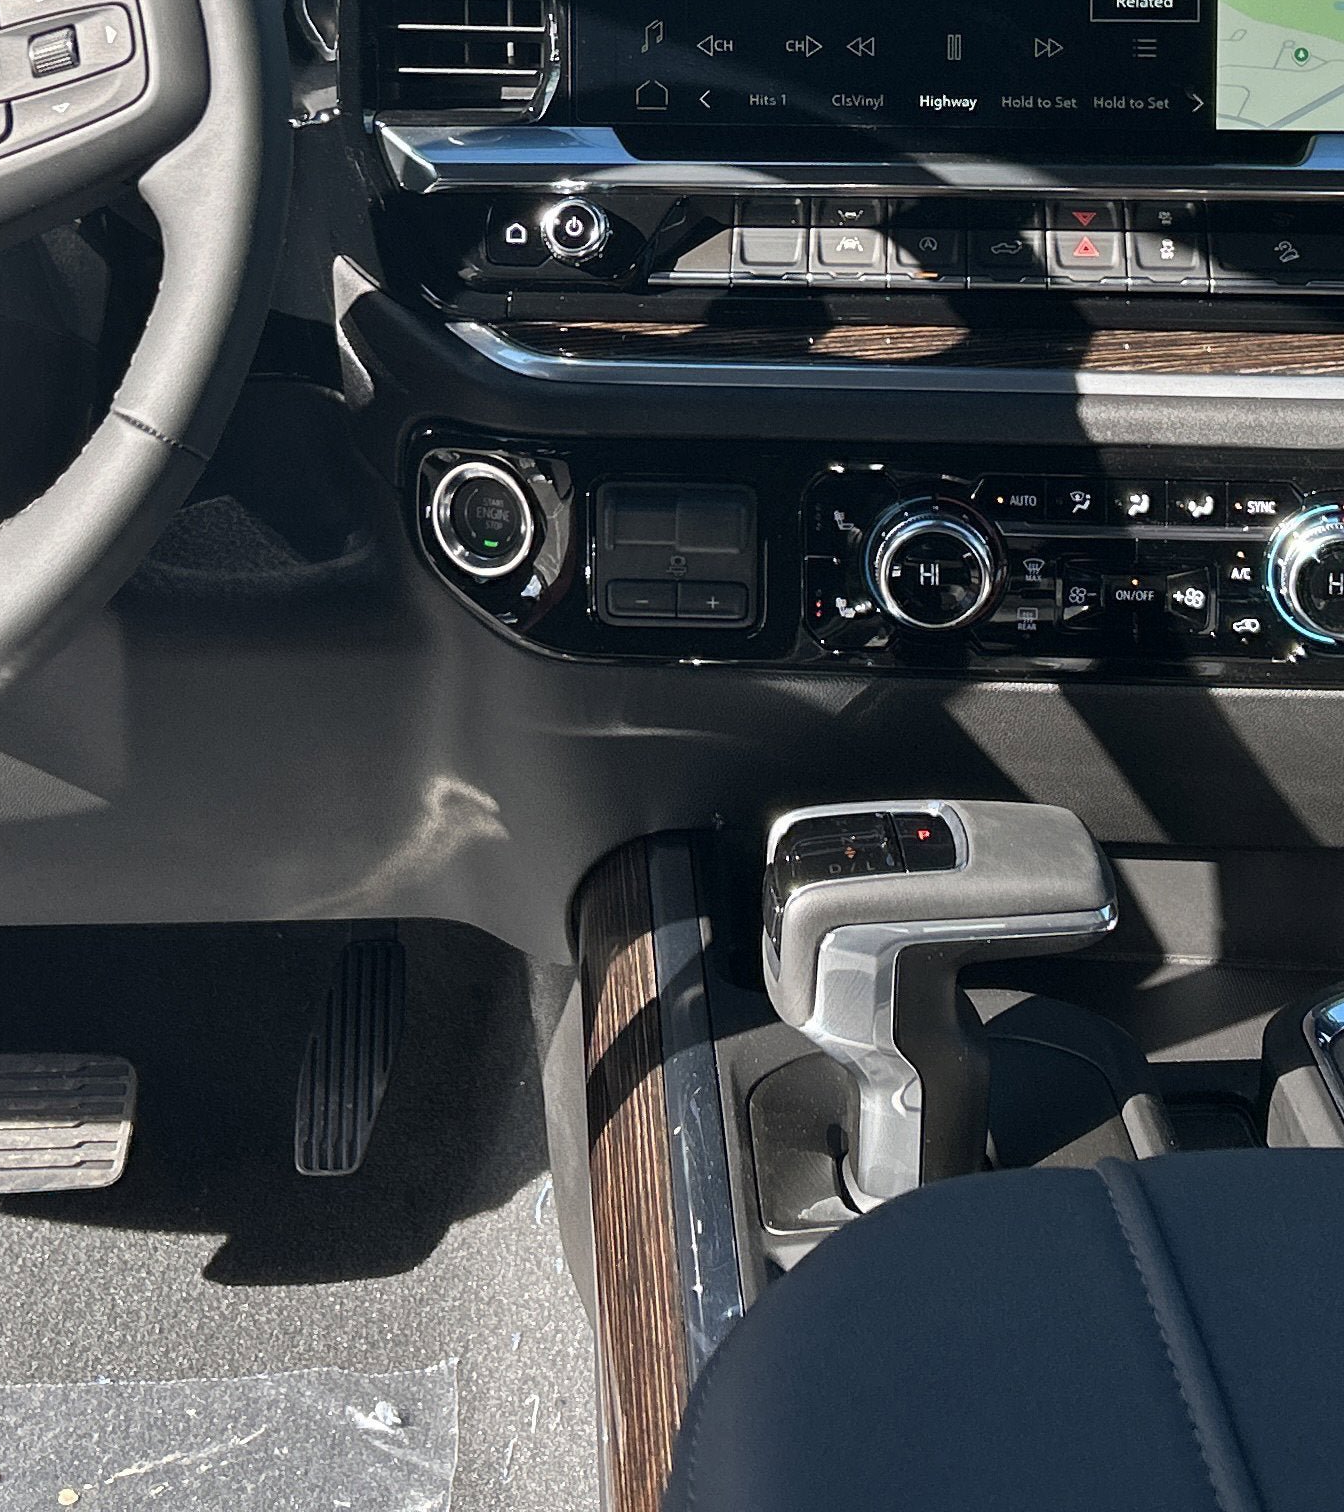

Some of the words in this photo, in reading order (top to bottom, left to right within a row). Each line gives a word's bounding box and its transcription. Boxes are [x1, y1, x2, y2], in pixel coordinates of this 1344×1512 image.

[714, 40, 734, 53] CH
[785, 40, 805, 53] CH
[749, 93, 777, 106] Hits
[780, 93, 787, 106] 1
[919, 95, 978, 112] Highway
[1001, 95, 1033, 109] Hold
[1036, 96, 1051, 109] to
[1054, 95, 1078, 109] Set
[1093, 96, 1125, 110] Hold
[1128, 97, 1143, 110] to
[1146, 96, 1170, 110] Set
[483, 497, 505, 508] START
[1010, 494, 1037, 507] AUTO
[1248, 500, 1275, 514] SYNC
[476, 506, 511, 523] ENGINE
[485, 519, 504, 531] STOP
[920, 563, 939, 586] HI
[1025, 574, 1042, 583] MAX
[1231, 567, 1251, 580] A/C
[1116, 589, 1154, 602] ON/OFF
[1017, 623, 1037, 631] REAR
[917, 829, 931, 840] P
